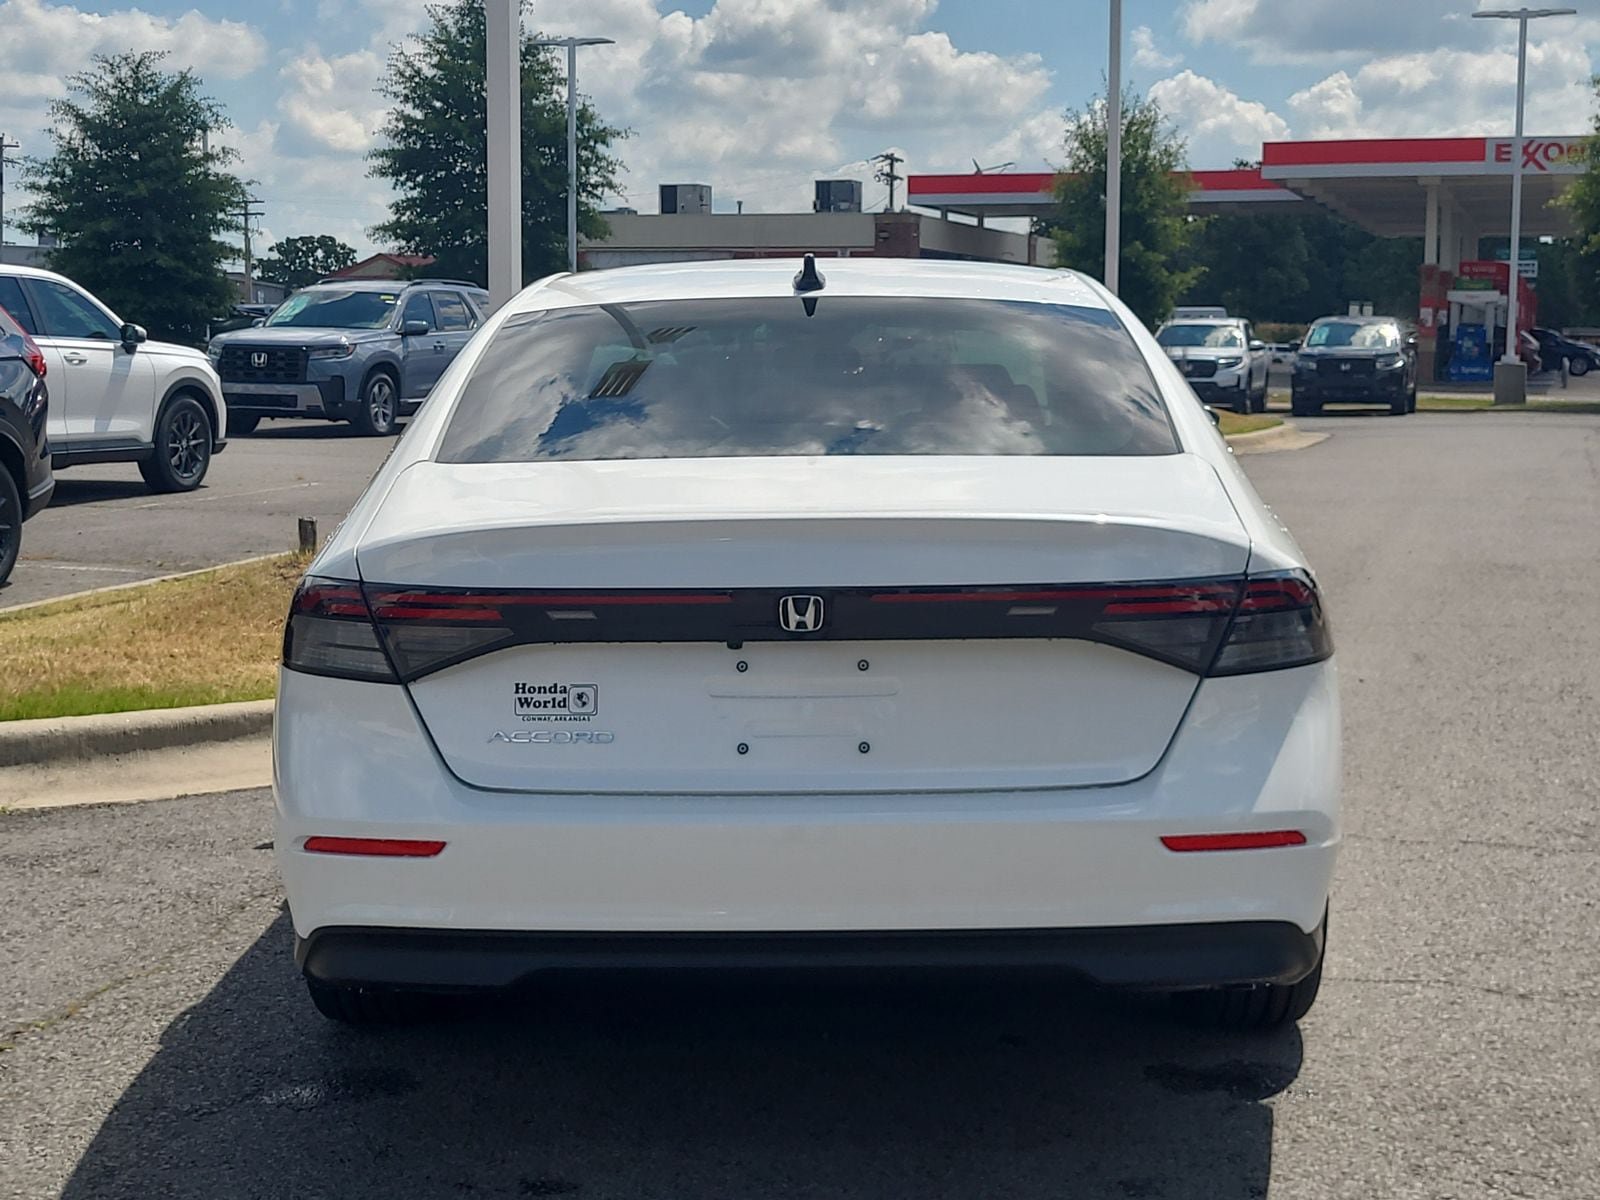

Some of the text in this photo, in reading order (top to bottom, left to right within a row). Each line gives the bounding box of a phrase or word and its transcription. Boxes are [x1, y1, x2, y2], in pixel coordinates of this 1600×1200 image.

[514, 683, 567, 694] Honda
[517, 697, 567, 708] World
[488, 730, 614, 744] ACCORD
